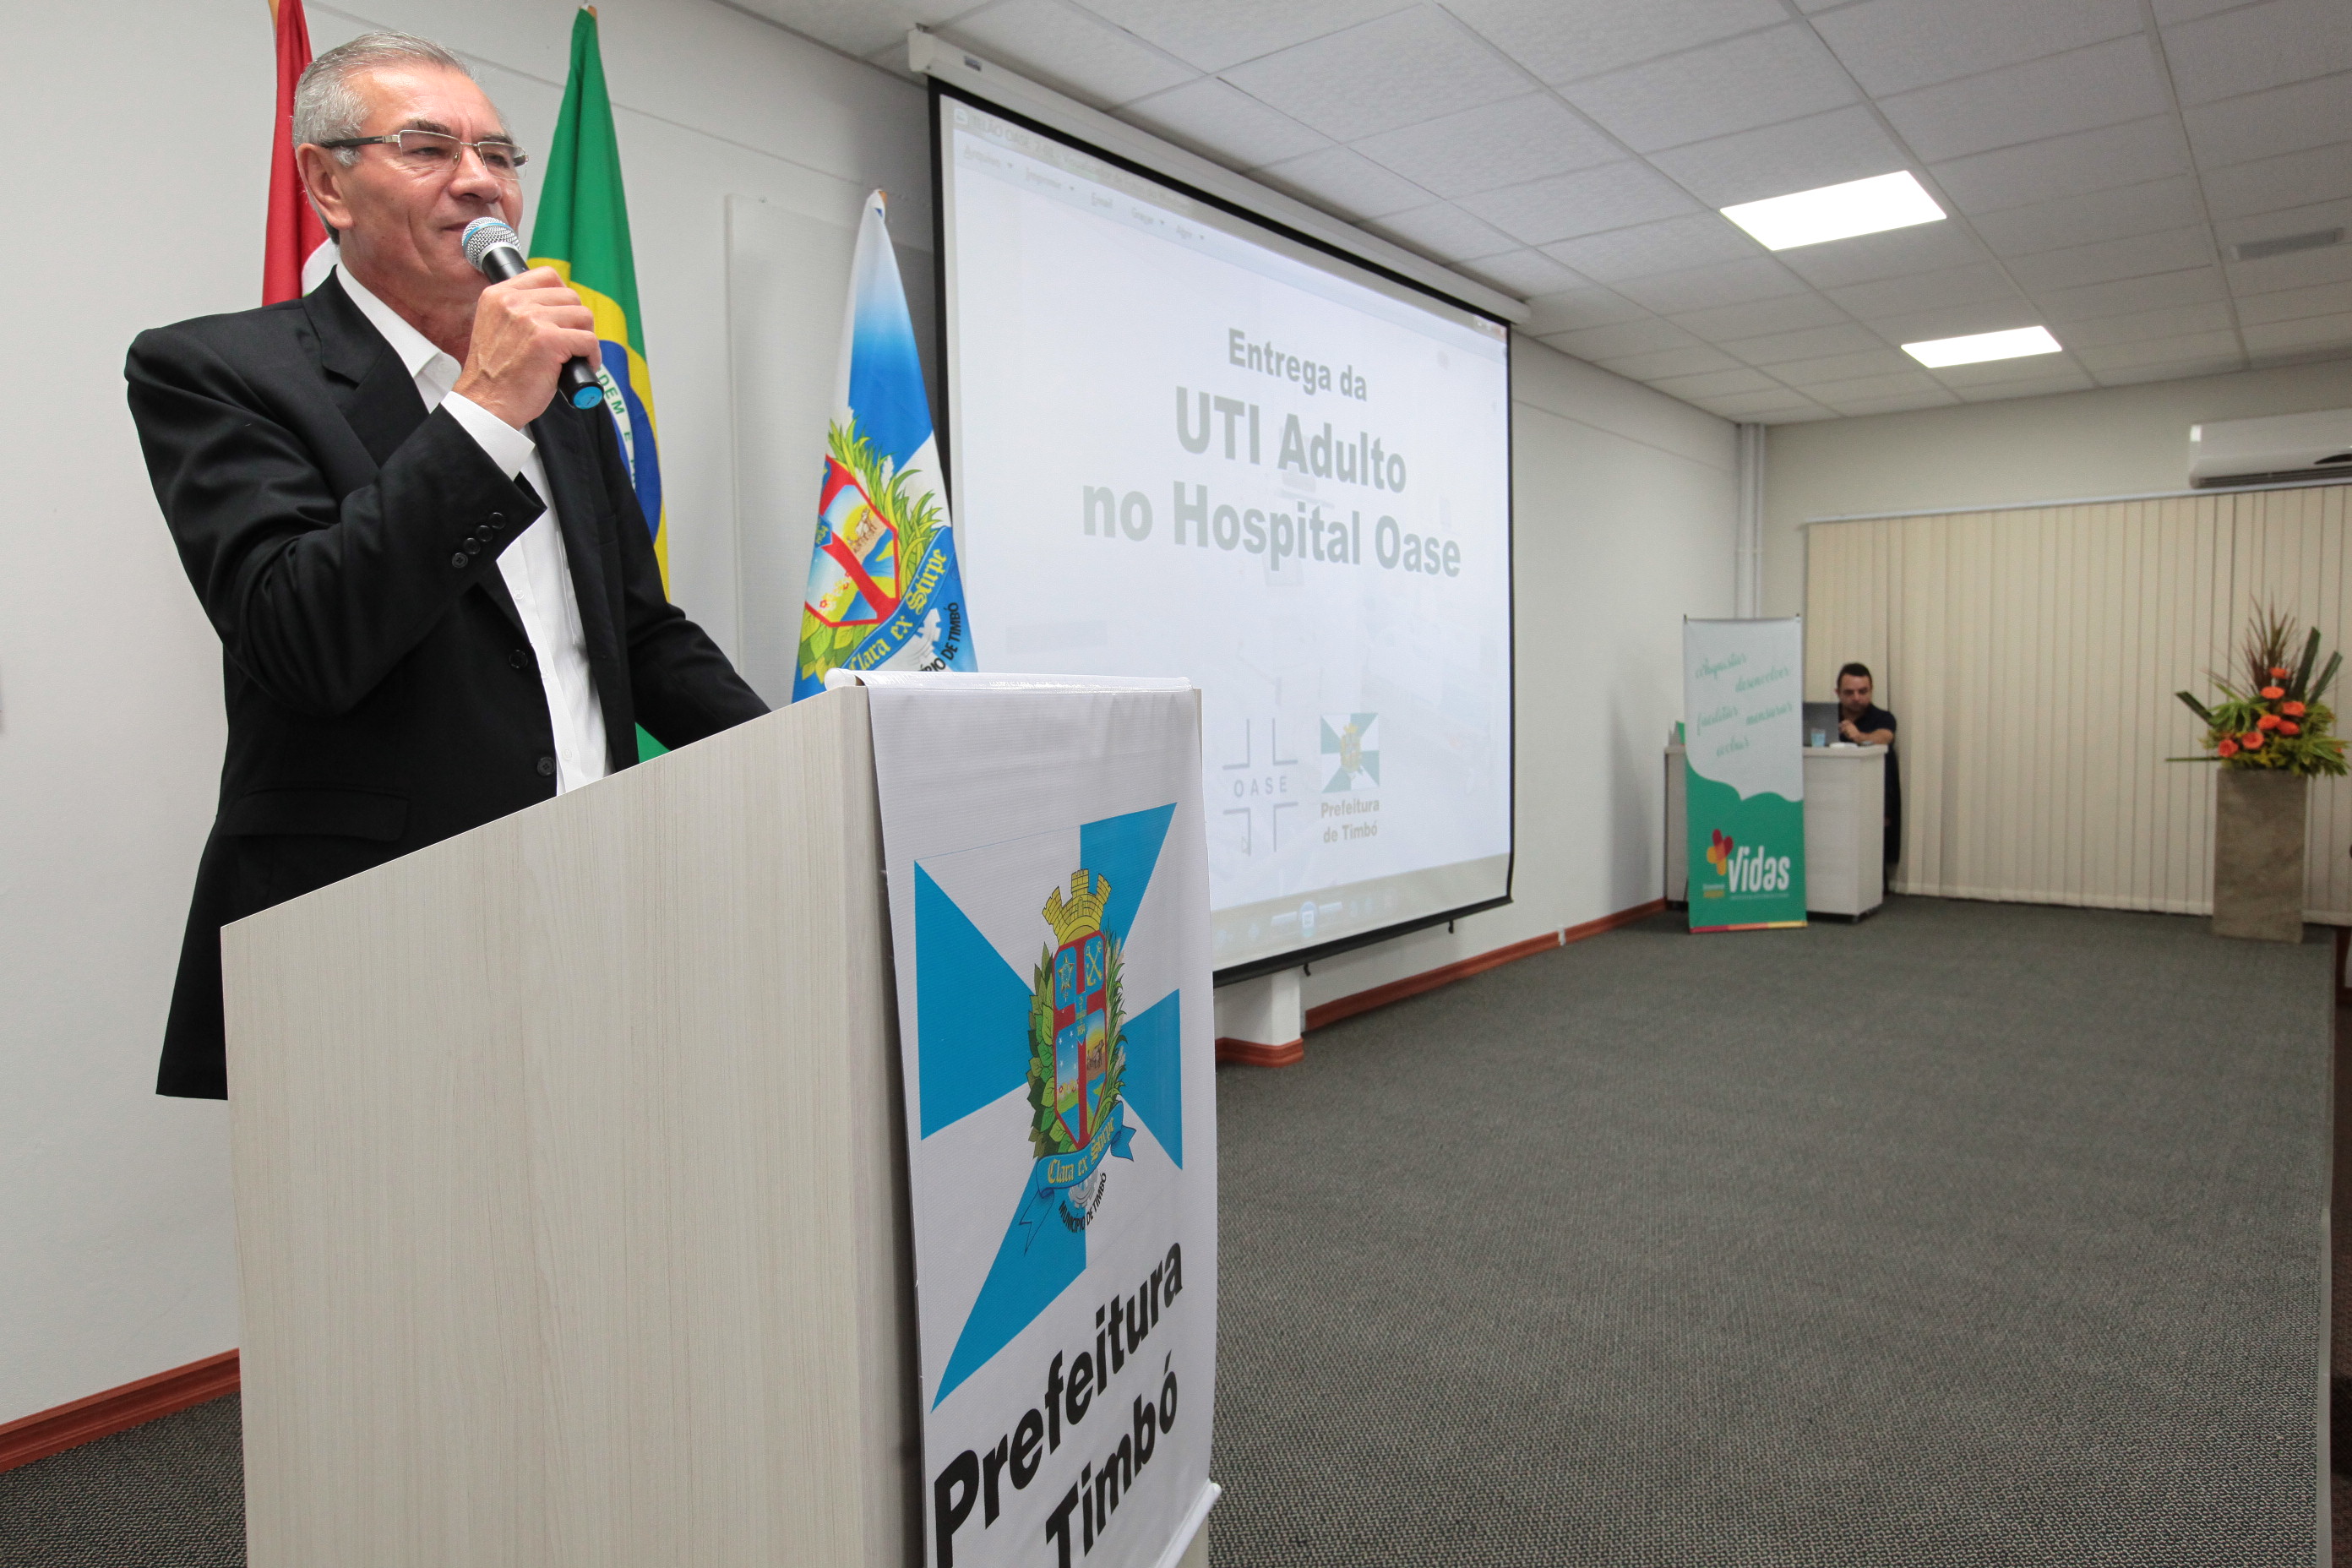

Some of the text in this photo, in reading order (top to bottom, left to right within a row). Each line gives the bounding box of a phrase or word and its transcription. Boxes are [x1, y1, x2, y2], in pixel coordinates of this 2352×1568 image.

[596, 366, 625, 414] DEM
[1228, 327, 1368, 401] Entrega da
[1175, 386, 1407, 494] UTI Adulto
[1082, 480, 1462, 578] no Hospital Oase
[940, 602, 961, 661] DE TIMBÓ
[1233, 776, 1288, 798] OASE
[1320, 798, 1380, 819] Prefeitura
[1323, 821, 1379, 844] de Timbó
[1729, 845, 1790, 892] Vidas
[1048, 1159, 1075, 1184] Clara
[1078, 1156, 1088, 1176] ex
[1059, 1172, 1107, 1233] MUNICÍPIO DE TIMBÓ
[934, 1242, 1183, 1568] Prefeitura
[1046, 1348, 1178, 1568] Timbó
